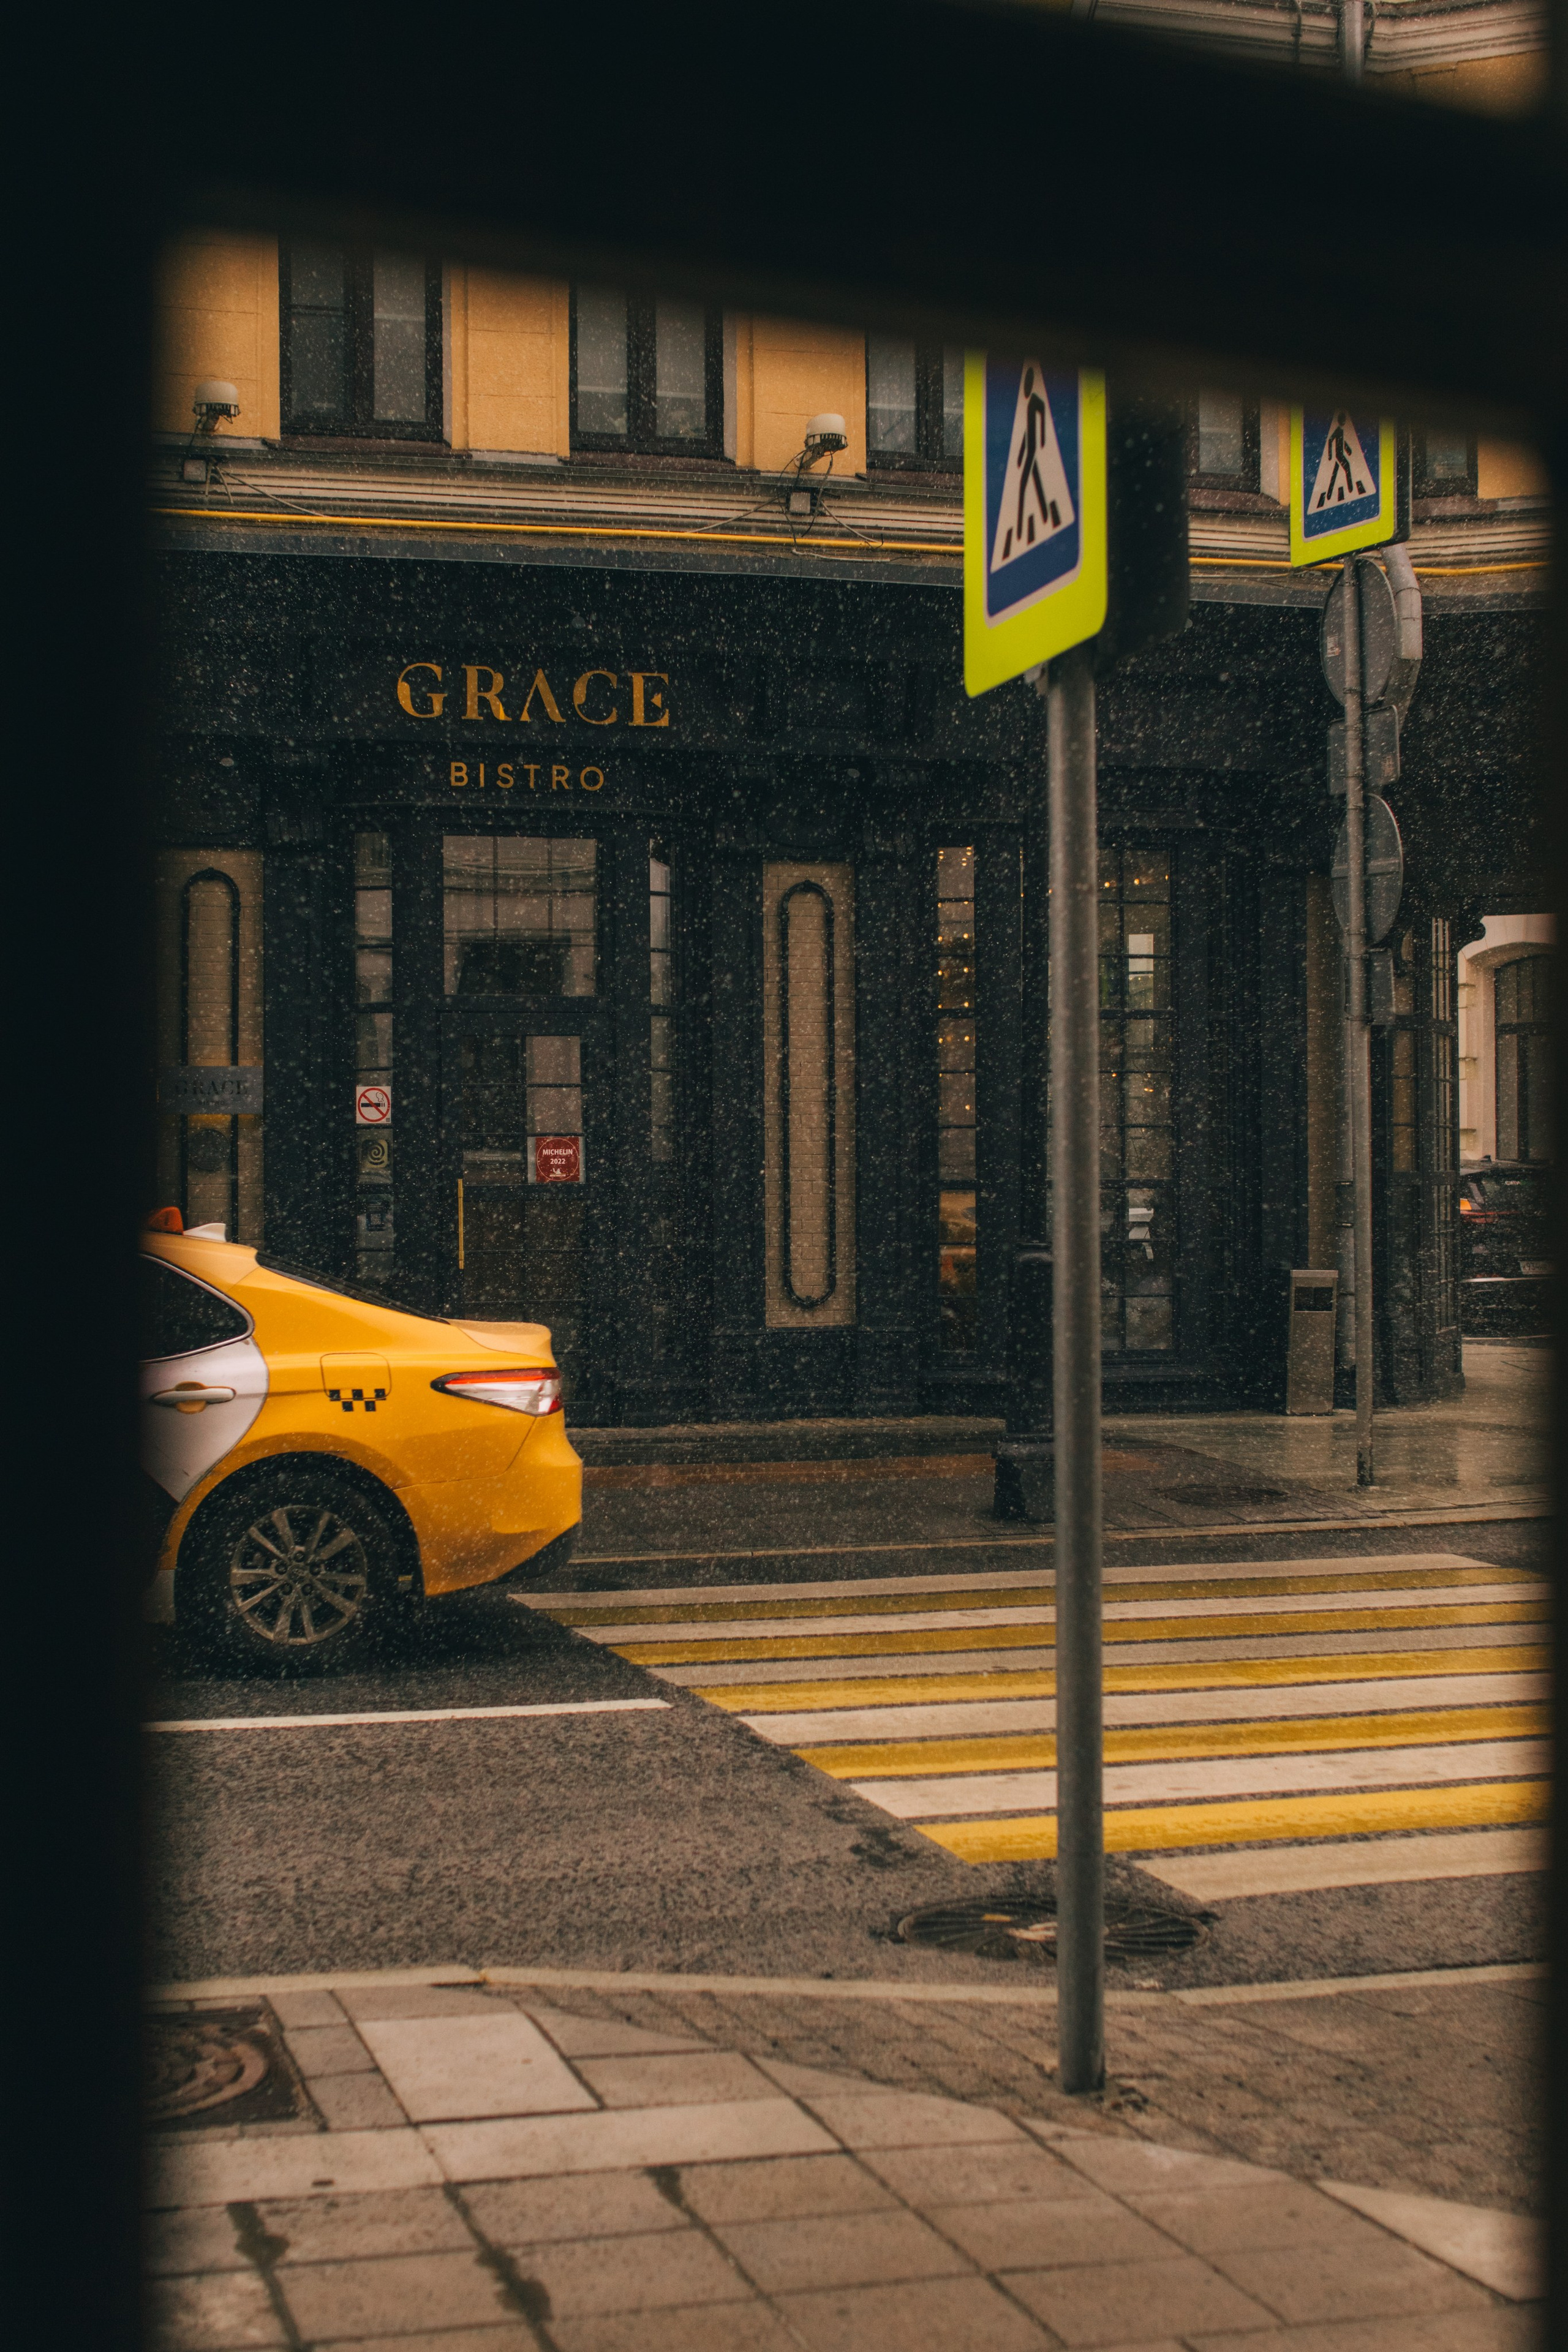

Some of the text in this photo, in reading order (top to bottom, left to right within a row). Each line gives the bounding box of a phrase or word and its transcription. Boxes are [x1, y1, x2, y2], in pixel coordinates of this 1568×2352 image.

[397, 663, 669, 726] GRACE
[450, 763, 605, 791] BISTRO
[175, 1079, 247, 1095] GRACE
